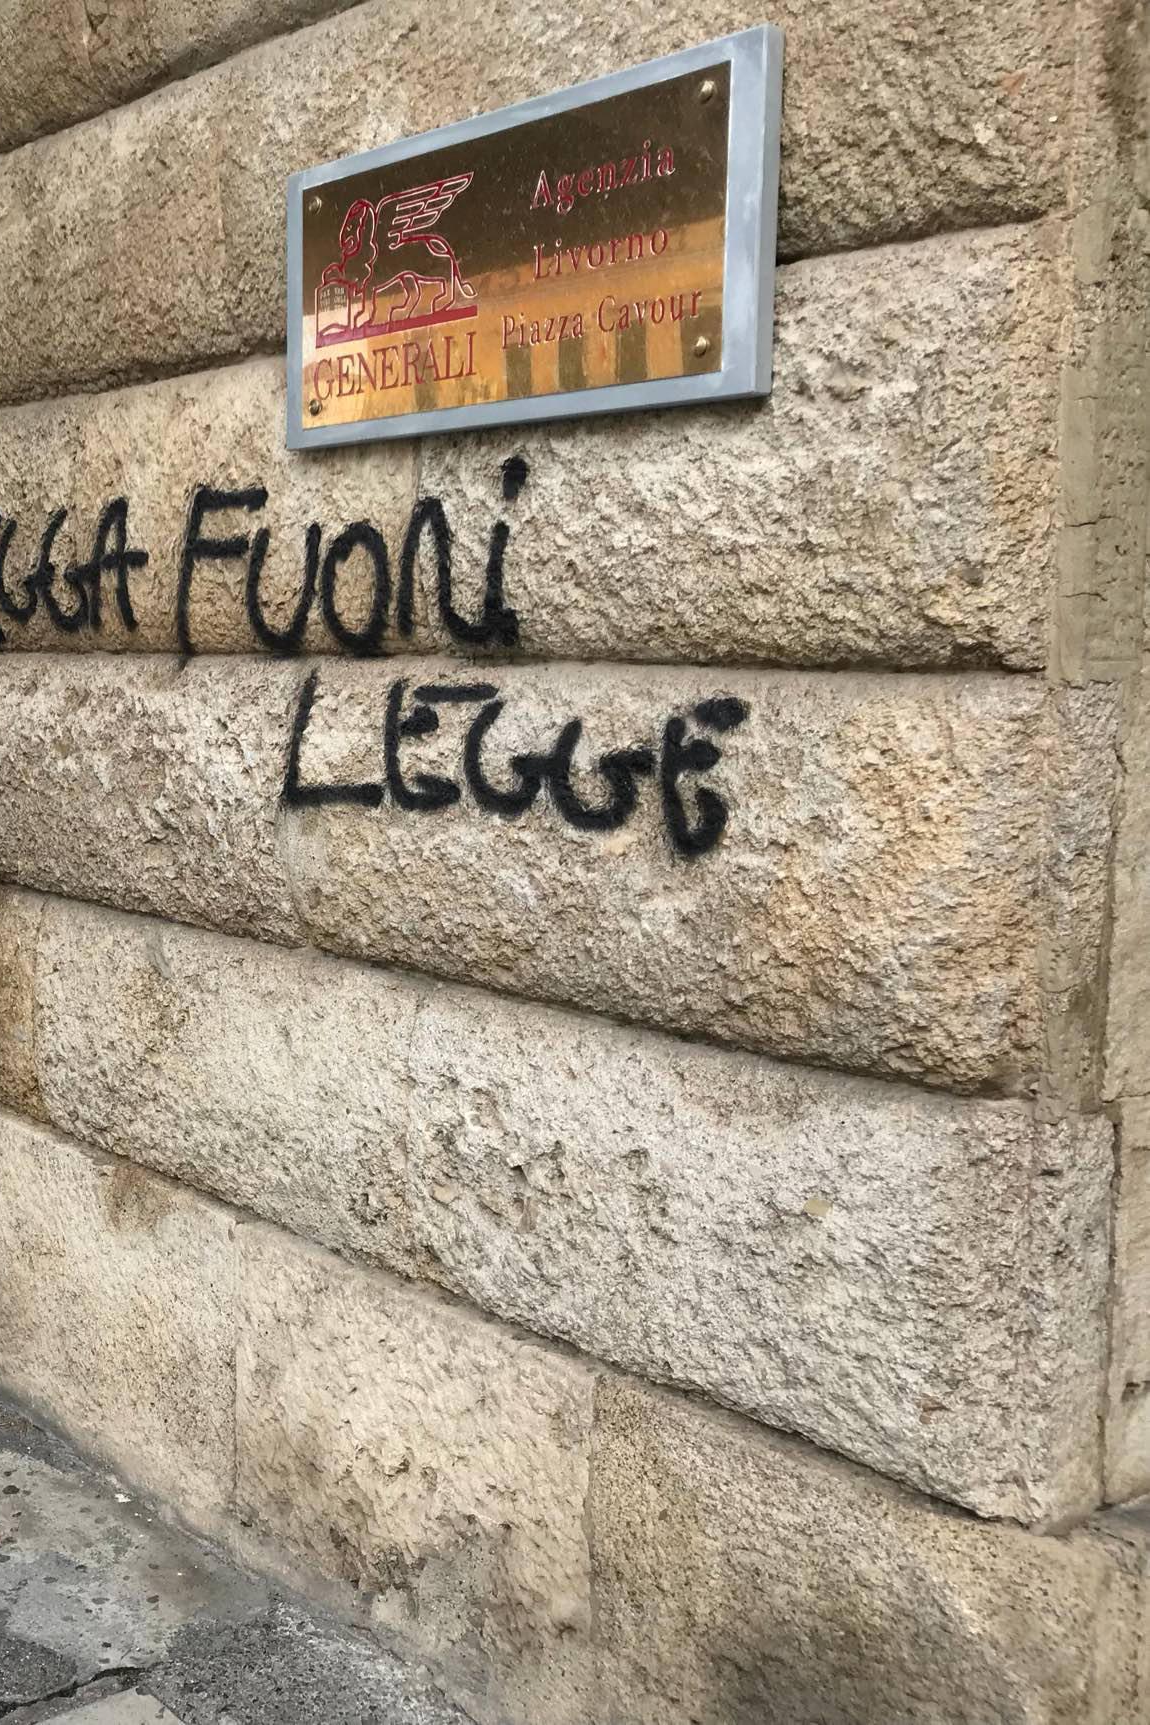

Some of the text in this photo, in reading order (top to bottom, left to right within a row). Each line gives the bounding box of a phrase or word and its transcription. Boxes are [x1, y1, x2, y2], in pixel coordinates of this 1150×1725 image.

[530, 139, 676, 214] Agenzia
[533, 226, 669, 280] Livorno
[502, 287, 702, 350] Piazza Cavour
[313, 332, 478, 401] GENERALI
